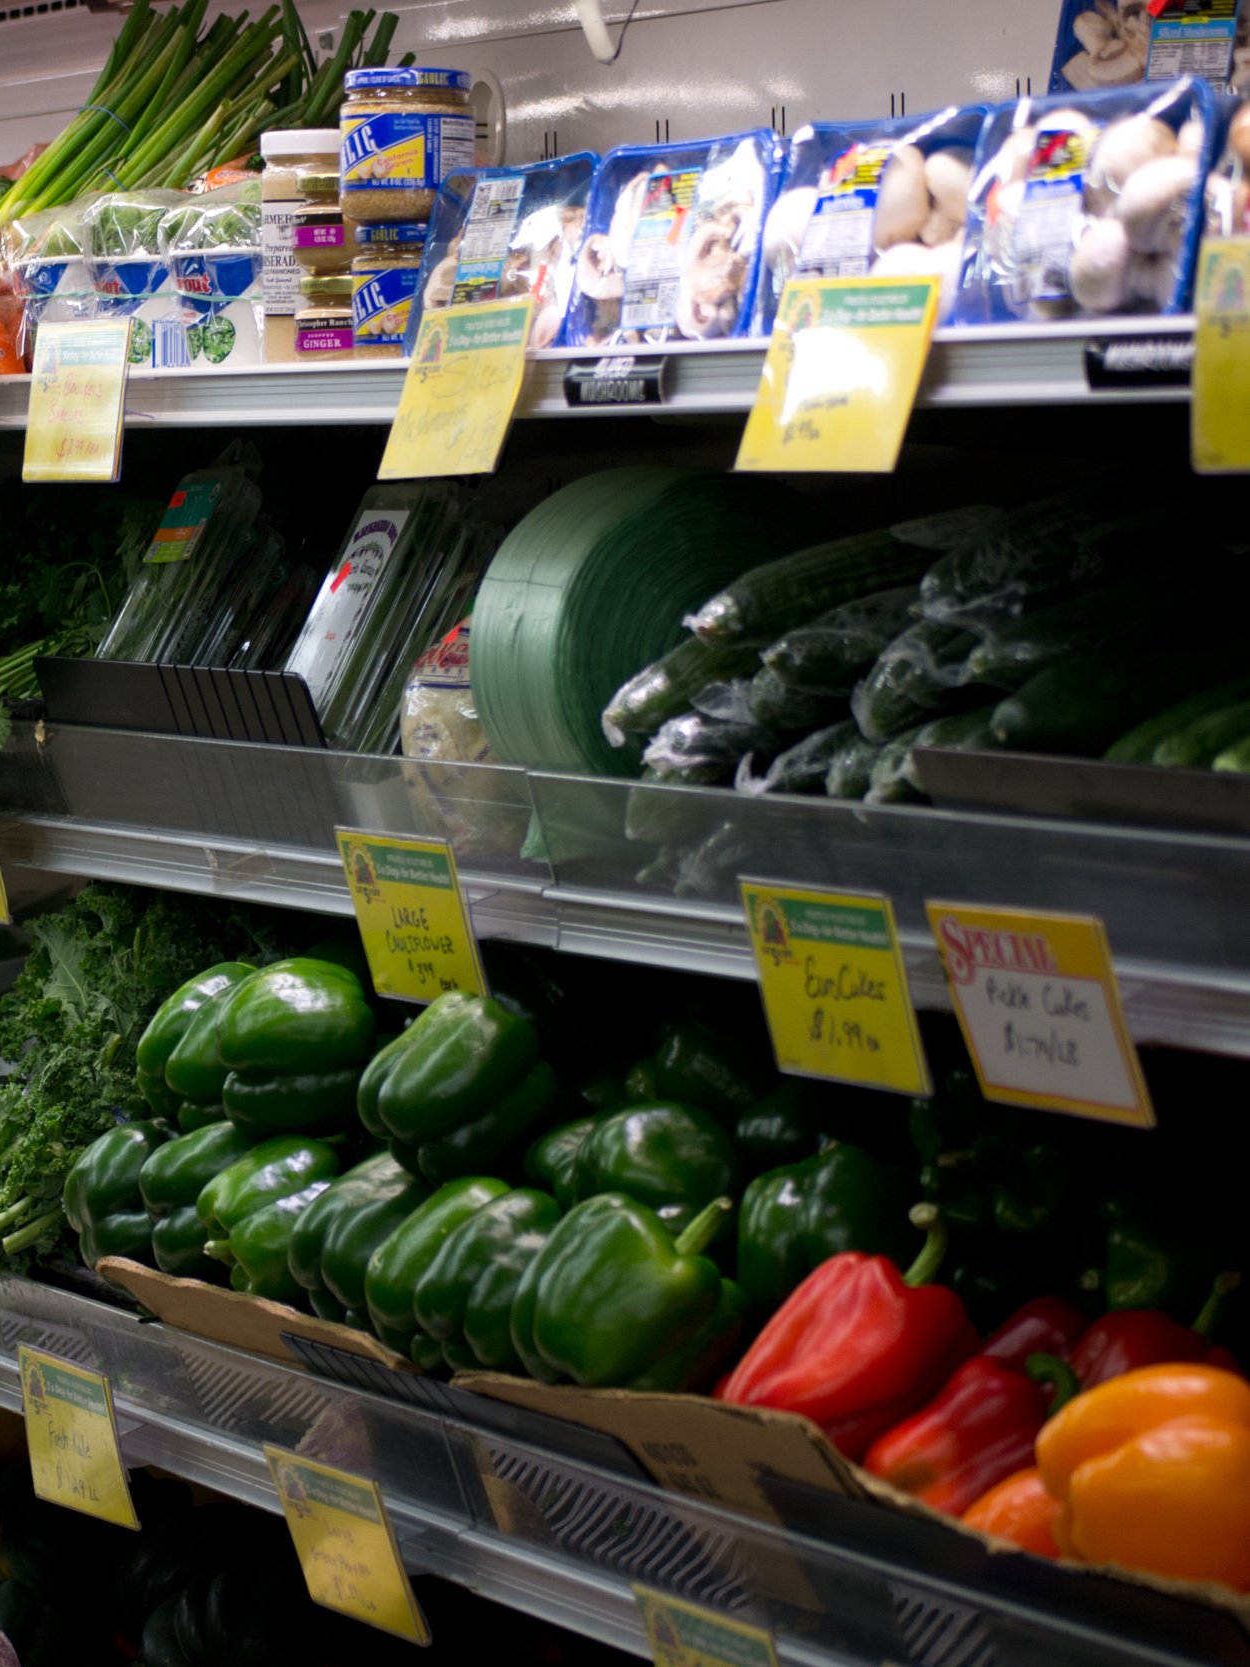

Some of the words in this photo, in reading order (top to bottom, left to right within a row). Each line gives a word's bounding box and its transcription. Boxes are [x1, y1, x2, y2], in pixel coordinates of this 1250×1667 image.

[377, 148, 419, 166] California
[385, 157, 414, 171] Grown
[264, 255, 297, 267] SERAD
[303, 339, 342, 349] GINGER
[580, 380, 646, 402] MUSHROOMS
[391, 906, 429, 931] LARGE
[386, 929, 455, 955] CAULIFLOWER
[940, 914, 1059, 986] SPECIAL
